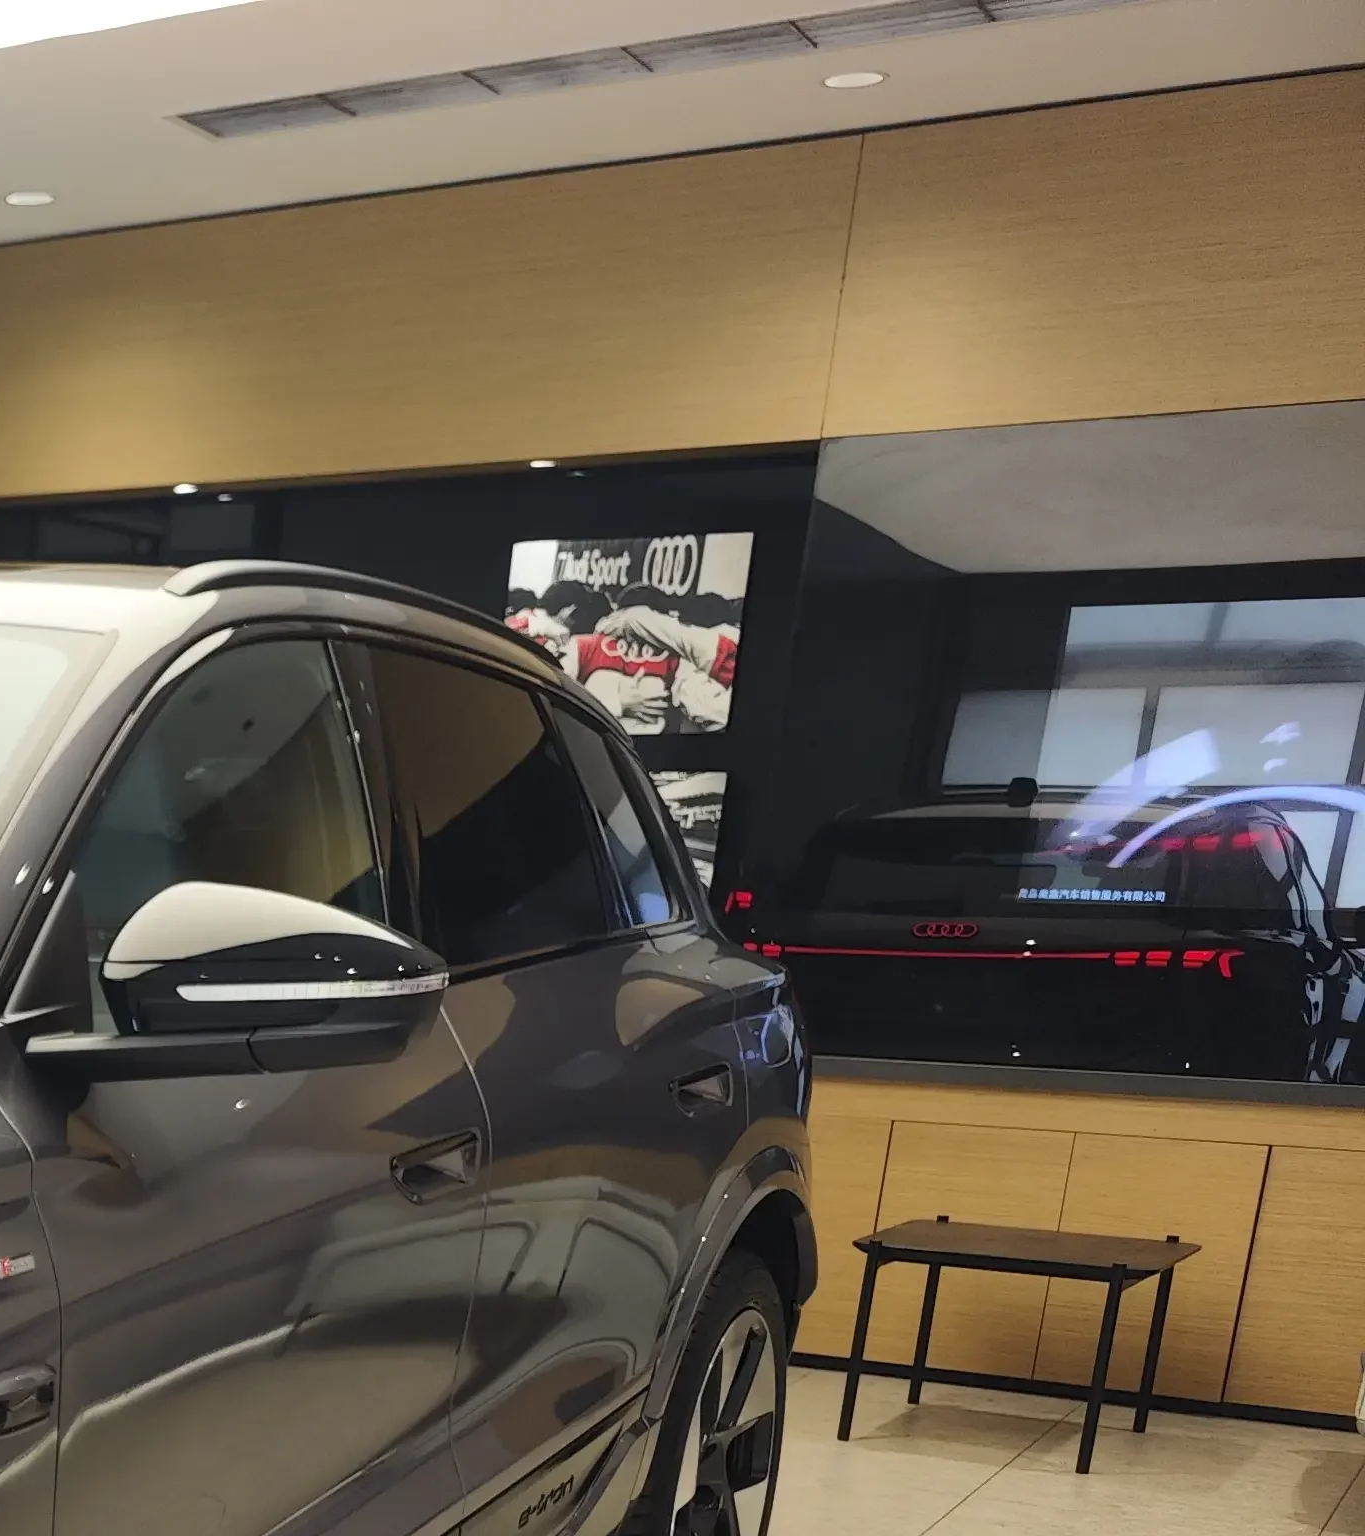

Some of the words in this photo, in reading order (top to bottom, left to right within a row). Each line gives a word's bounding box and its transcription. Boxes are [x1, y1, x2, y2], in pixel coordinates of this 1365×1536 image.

[561, 549, 590, 584] Audi
[588, 548, 631, 593] Sport
[518, 1474, 574, 1530] e-tron
